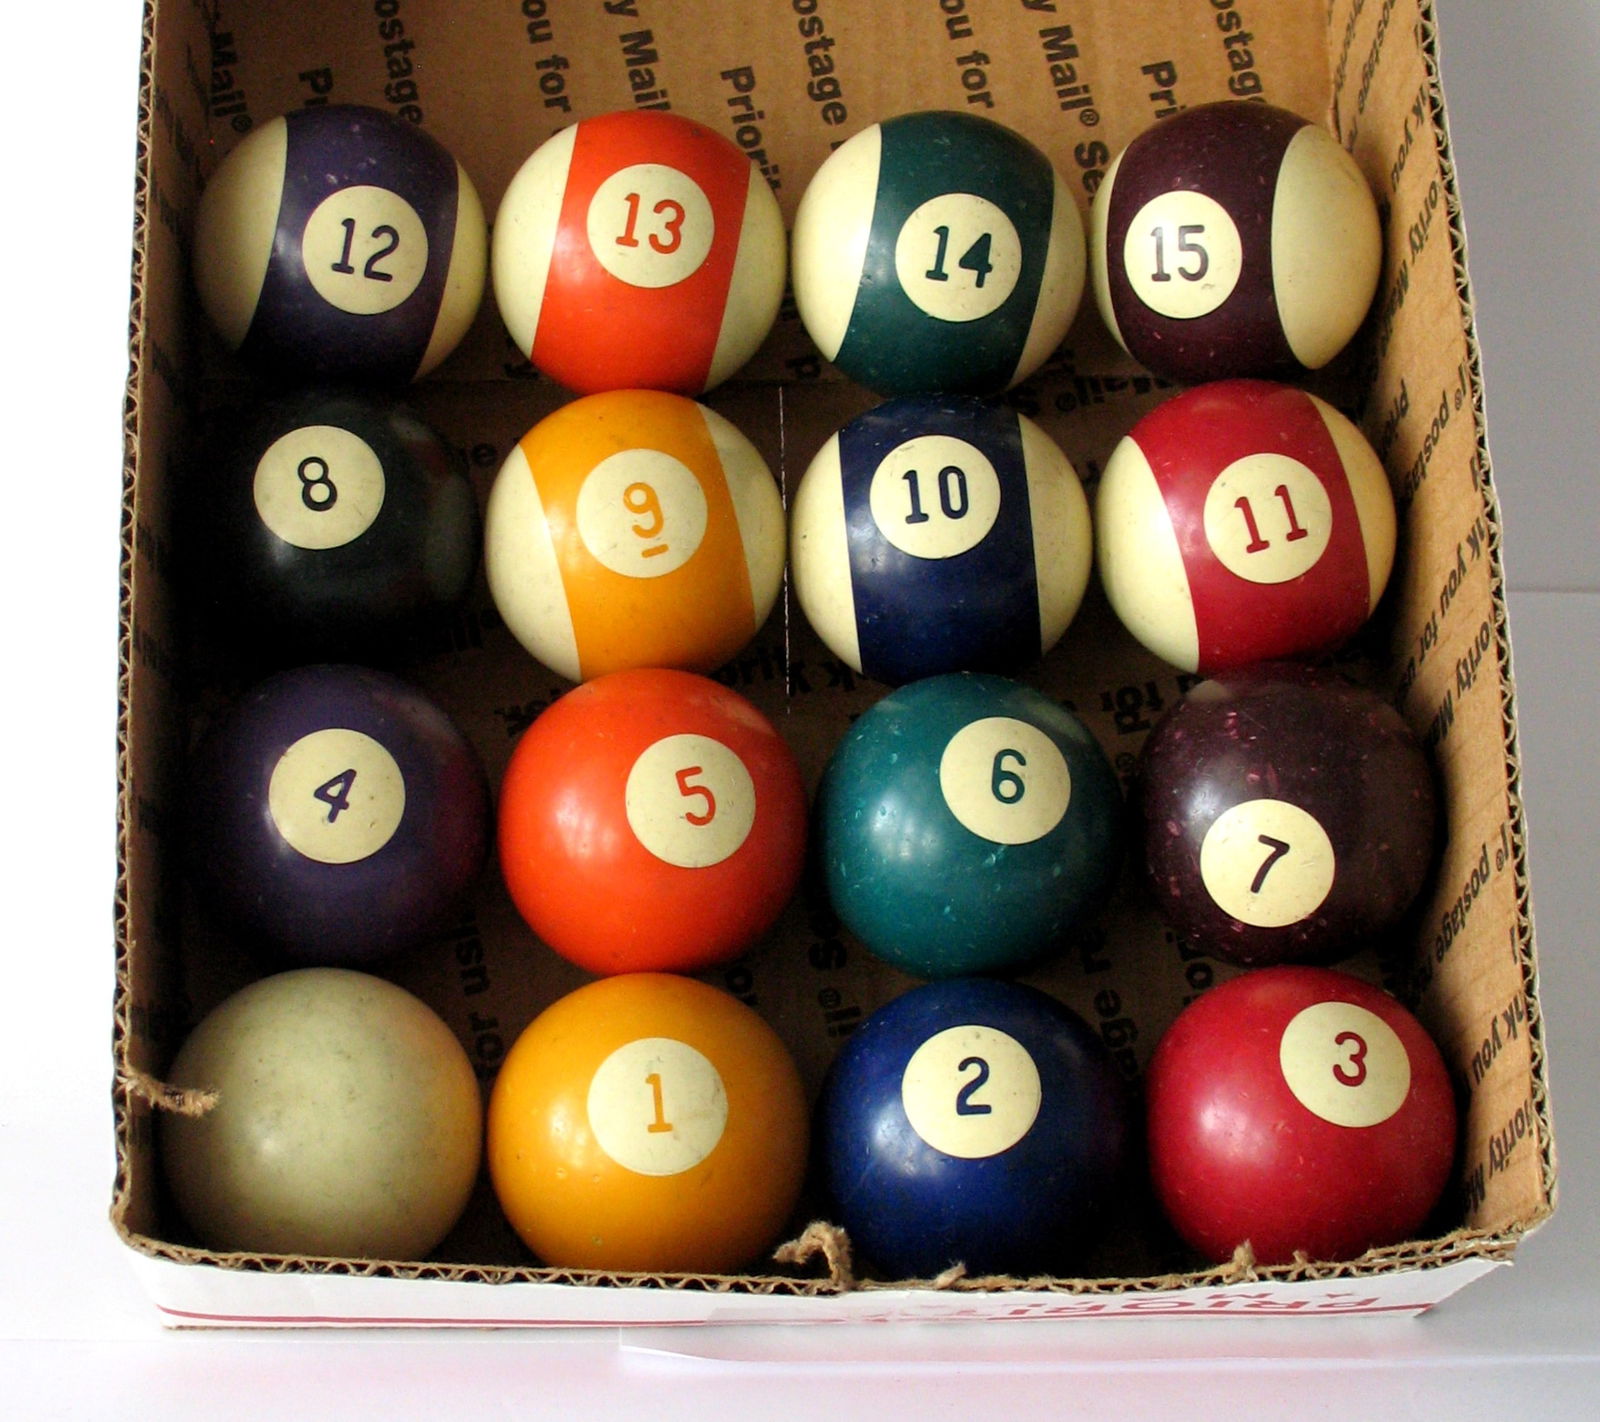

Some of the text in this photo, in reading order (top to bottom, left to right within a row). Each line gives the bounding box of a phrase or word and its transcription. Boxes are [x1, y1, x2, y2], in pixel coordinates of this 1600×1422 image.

[374, 0, 422, 125] ostage
[521, 0, 571, 112] ou for
[792, 0, 847, 125] ostage
[940, 0, 994, 108] ou for
[331, 218, 399, 282] 12
[615, 193, 685, 254] 13
[1150, 225, 1209, 282] 15
[1408, 181, 1439, 265] ority
[926, 226, 993, 288] 14
[298, 457, 337, 511] 8
[624, 482, 664, 538] 9
[902, 466, 968, 524] 10
[1234, 484, 1308, 553] 11
[1440, 542, 1467, 618] you
[1456, 621, 1490, 699] ority
[314, 769, 356, 823] 4
[675, 766, 716, 826] 5
[992, 749, 1026, 803] 6
[1251, 834, 1290, 893] 7
[1435, 842, 1490, 963] postage
[1333, 1031, 1367, 1087] 3
[1472, 1015, 1503, 1085] you
[645, 1073, 673, 1133] 1
[957, 1056, 992, 1115] 2
[1488, 1099, 1534, 1180] iority
